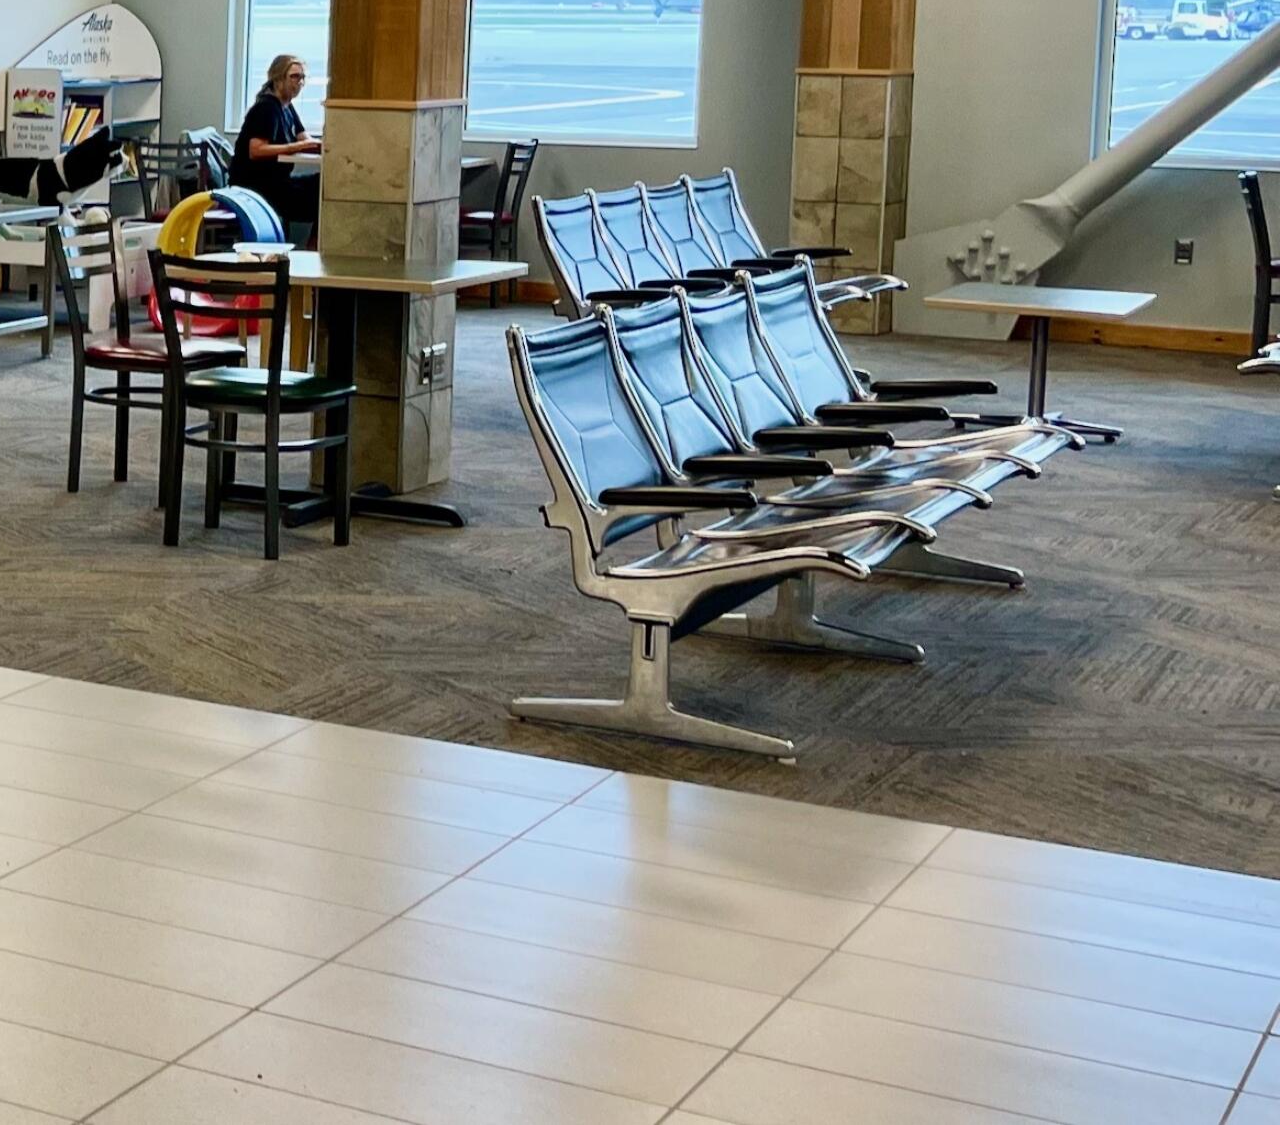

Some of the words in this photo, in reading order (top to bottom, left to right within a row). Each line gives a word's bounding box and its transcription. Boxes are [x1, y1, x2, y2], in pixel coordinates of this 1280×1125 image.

[82, 12, 113, 34] Alaska
[46, 49, 69, 66] Read
[70, 52, 82, 65] on
[84, 48, 98, 64] the
[100, 46, 112, 67] fly.
